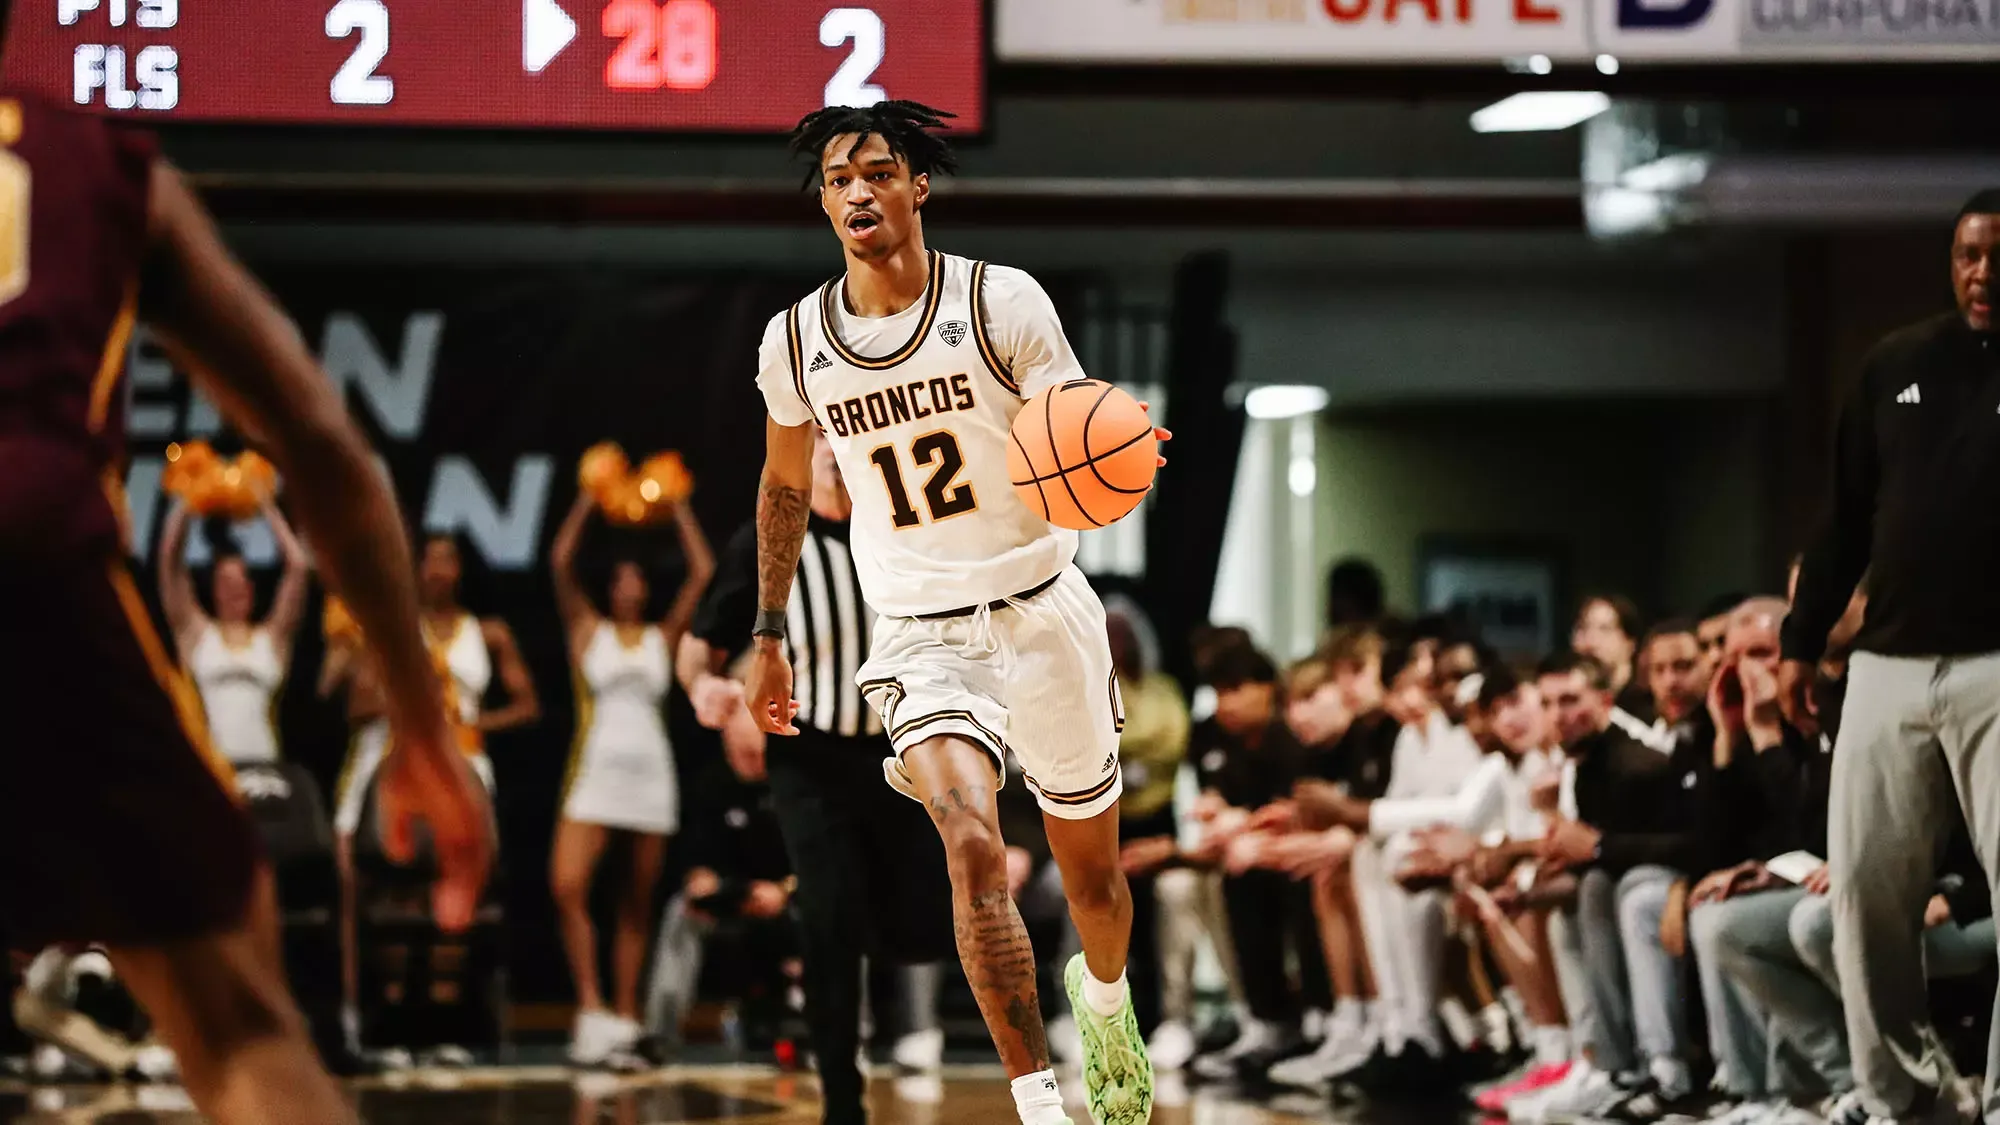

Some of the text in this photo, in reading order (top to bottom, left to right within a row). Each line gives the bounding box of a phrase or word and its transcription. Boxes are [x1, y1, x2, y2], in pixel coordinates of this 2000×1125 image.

[74, 44, 178, 109] FLS
[326, 0, 393, 103] 2
[602, 0, 718, 90] 28
[819, 8, 887, 108] 2
[809, 360, 833, 372] adidas
[826, 372, 976, 438] BRONCOS
[868, 428, 980, 531] 12
